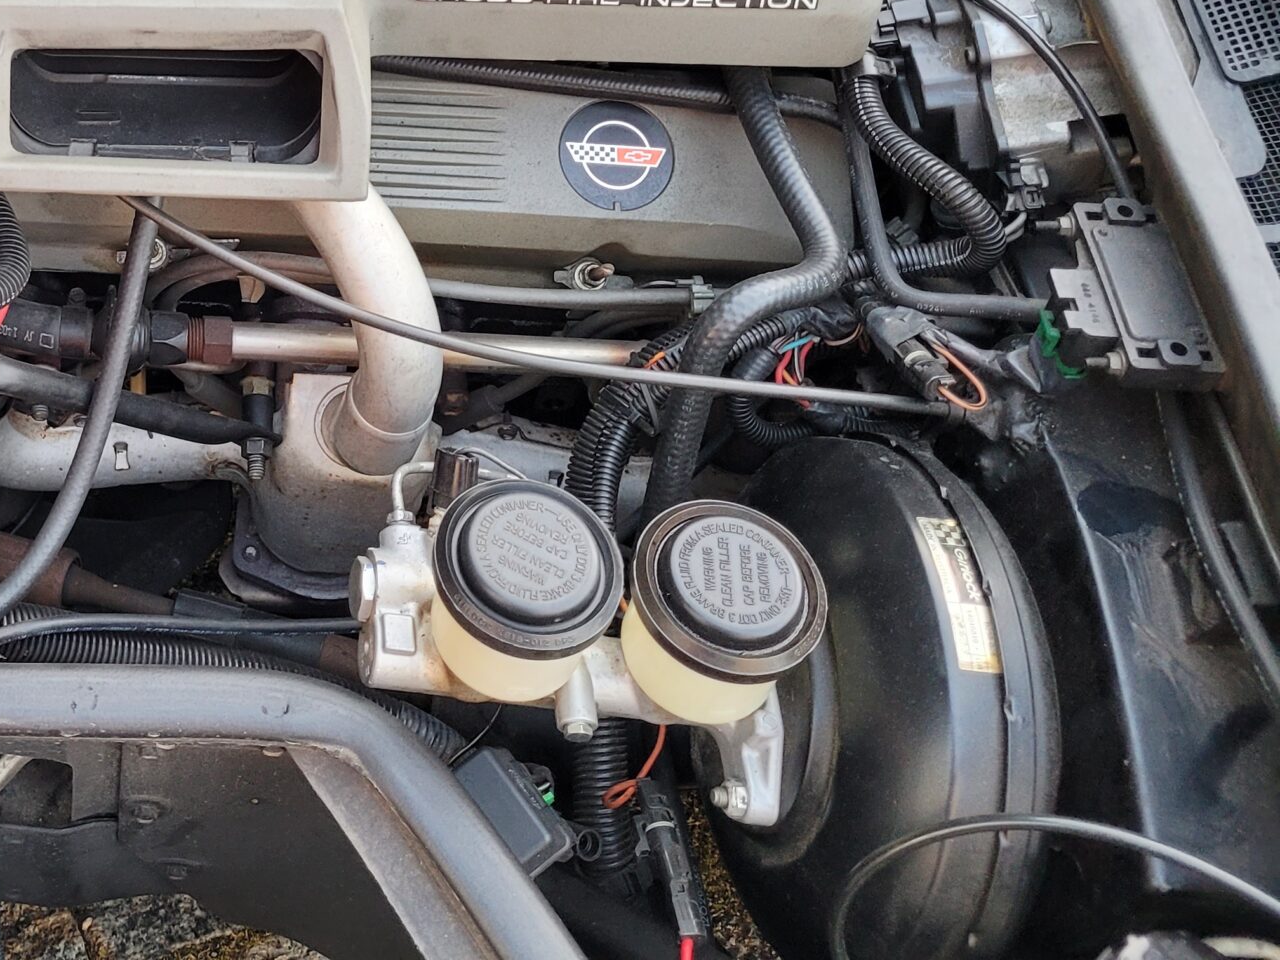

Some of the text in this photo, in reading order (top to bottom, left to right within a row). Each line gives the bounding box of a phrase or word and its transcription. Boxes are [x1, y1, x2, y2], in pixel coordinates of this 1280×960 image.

[490, 534, 565, 579] CLEAN FILLER
[545, 544, 568, 560] CAP
[678, 560, 696, 589] FLUID
[701, 522, 744, 535] SEALED
[701, 546, 715, 591] WARNING
[716, 535, 734, 608] CLEAN FILLER
[738, 542, 755, 606] CAP BEFORE
[755, 550, 771, 603] REMOVING
